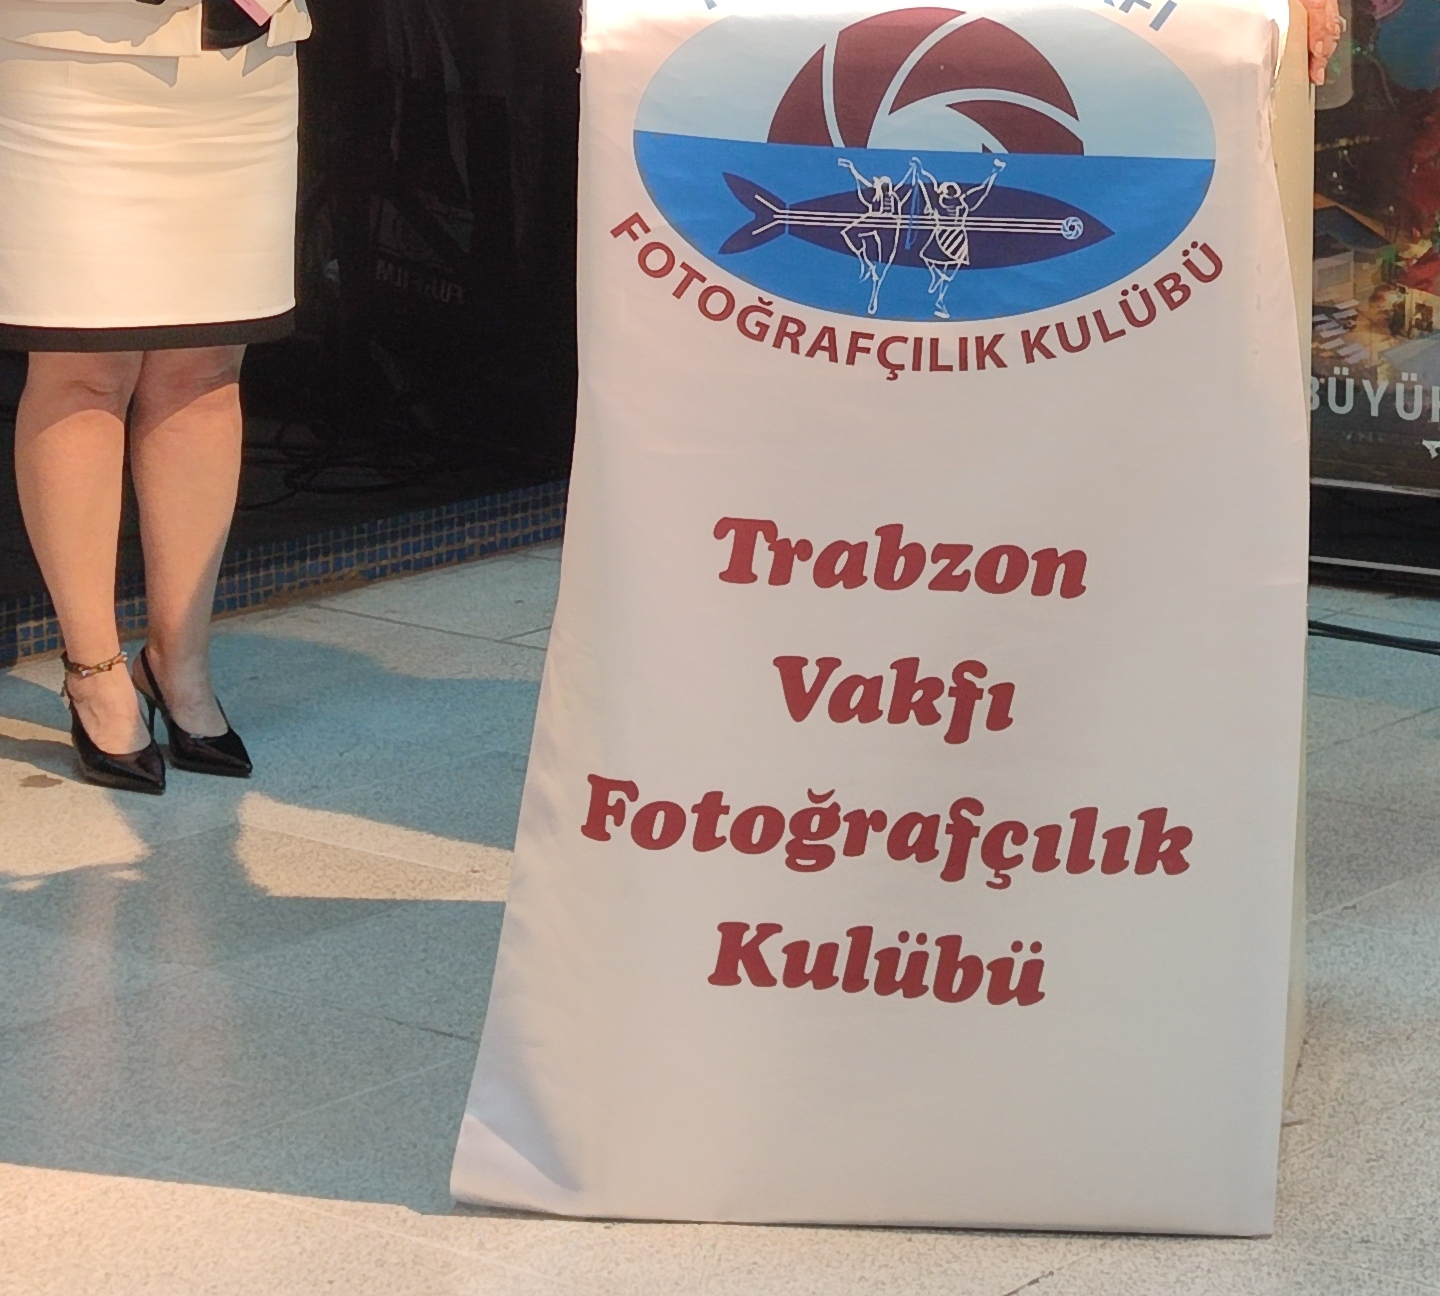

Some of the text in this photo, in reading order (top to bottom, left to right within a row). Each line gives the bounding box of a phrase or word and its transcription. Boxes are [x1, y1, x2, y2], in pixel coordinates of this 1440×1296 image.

[610, 211, 1225, 381] FOTOĞRAFÇILIK KULÜBÜ
[712, 516, 1088, 600] Trabzon
[772, 655, 1016, 746] Vakfı
[580, 773, 1194, 891] Fotoğrafçılık
[707, 921, 1046, 1007] Kulübü
